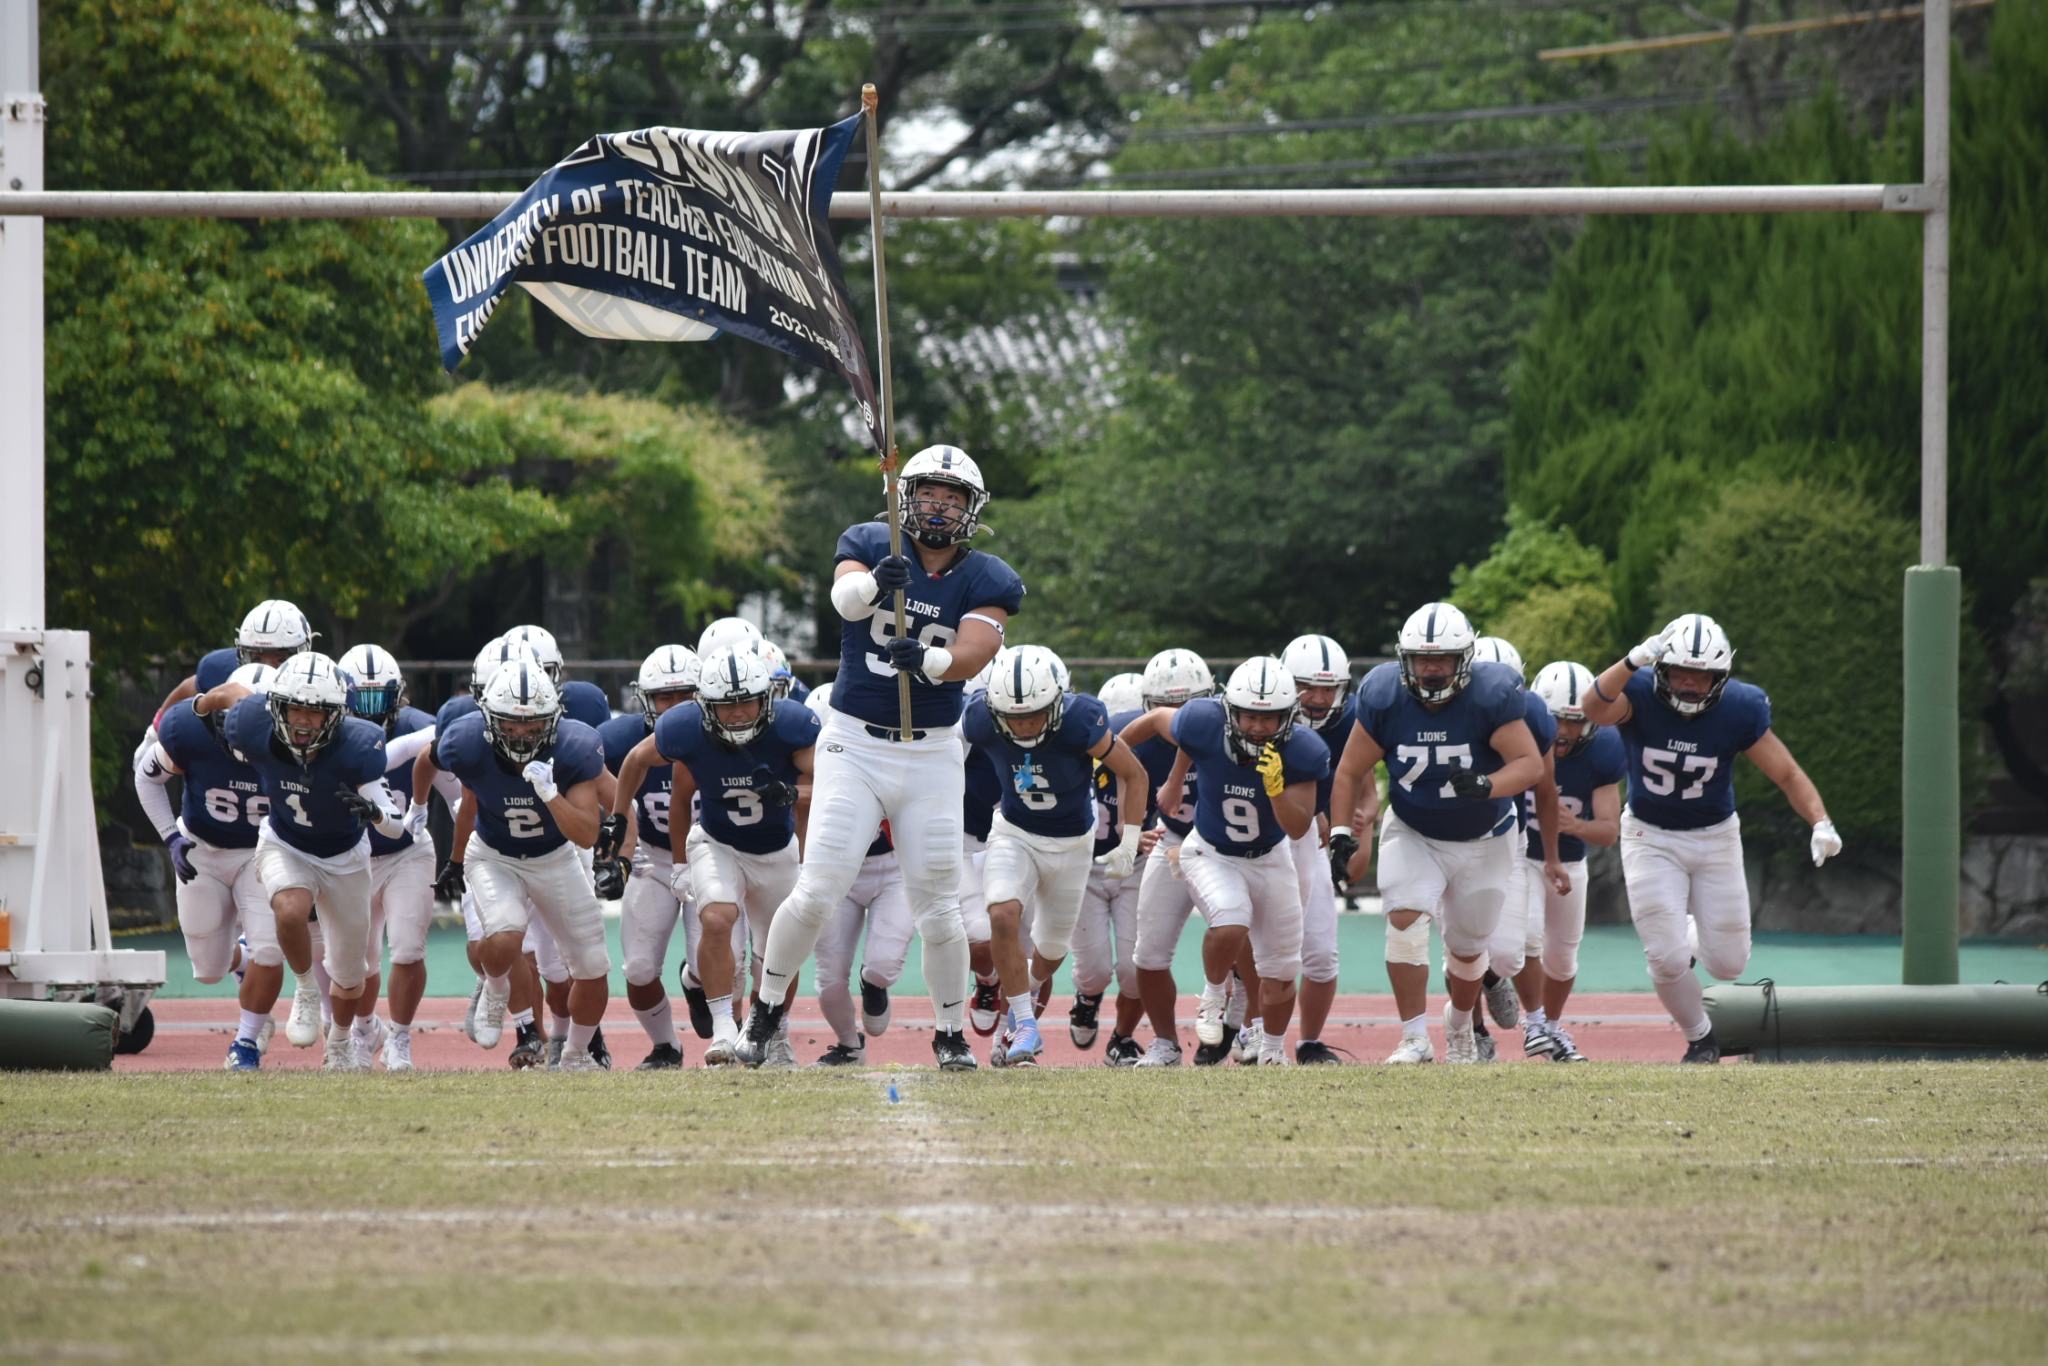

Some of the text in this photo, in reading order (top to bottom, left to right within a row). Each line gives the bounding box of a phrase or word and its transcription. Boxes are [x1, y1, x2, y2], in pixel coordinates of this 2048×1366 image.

[441, 193, 560, 304] UNIVERSITY
[571, 184, 606, 216] OF
[713, 211, 817, 311] EDUCATION
[543, 222, 747, 314] FOOTBALL TEAM
[904, 598, 941, 618] LIONS
[1416, 731, 1448, 742] LIONS
[1666, 739, 1699, 753] LIONS
[721, 776, 754, 787] LIONS
[1396, 743, 1474, 799] 77
[1642, 746, 1719, 800] 57
[229, 780, 258, 793] LIONS
[503, 797, 535, 806] LIONS
[1223, 784, 1256, 799] LIONS
[285, 793, 313, 827] 1
[722, 788, 764, 827] 3
[1222, 797, 1260, 843] 9
[503, 808, 545, 838] 2
